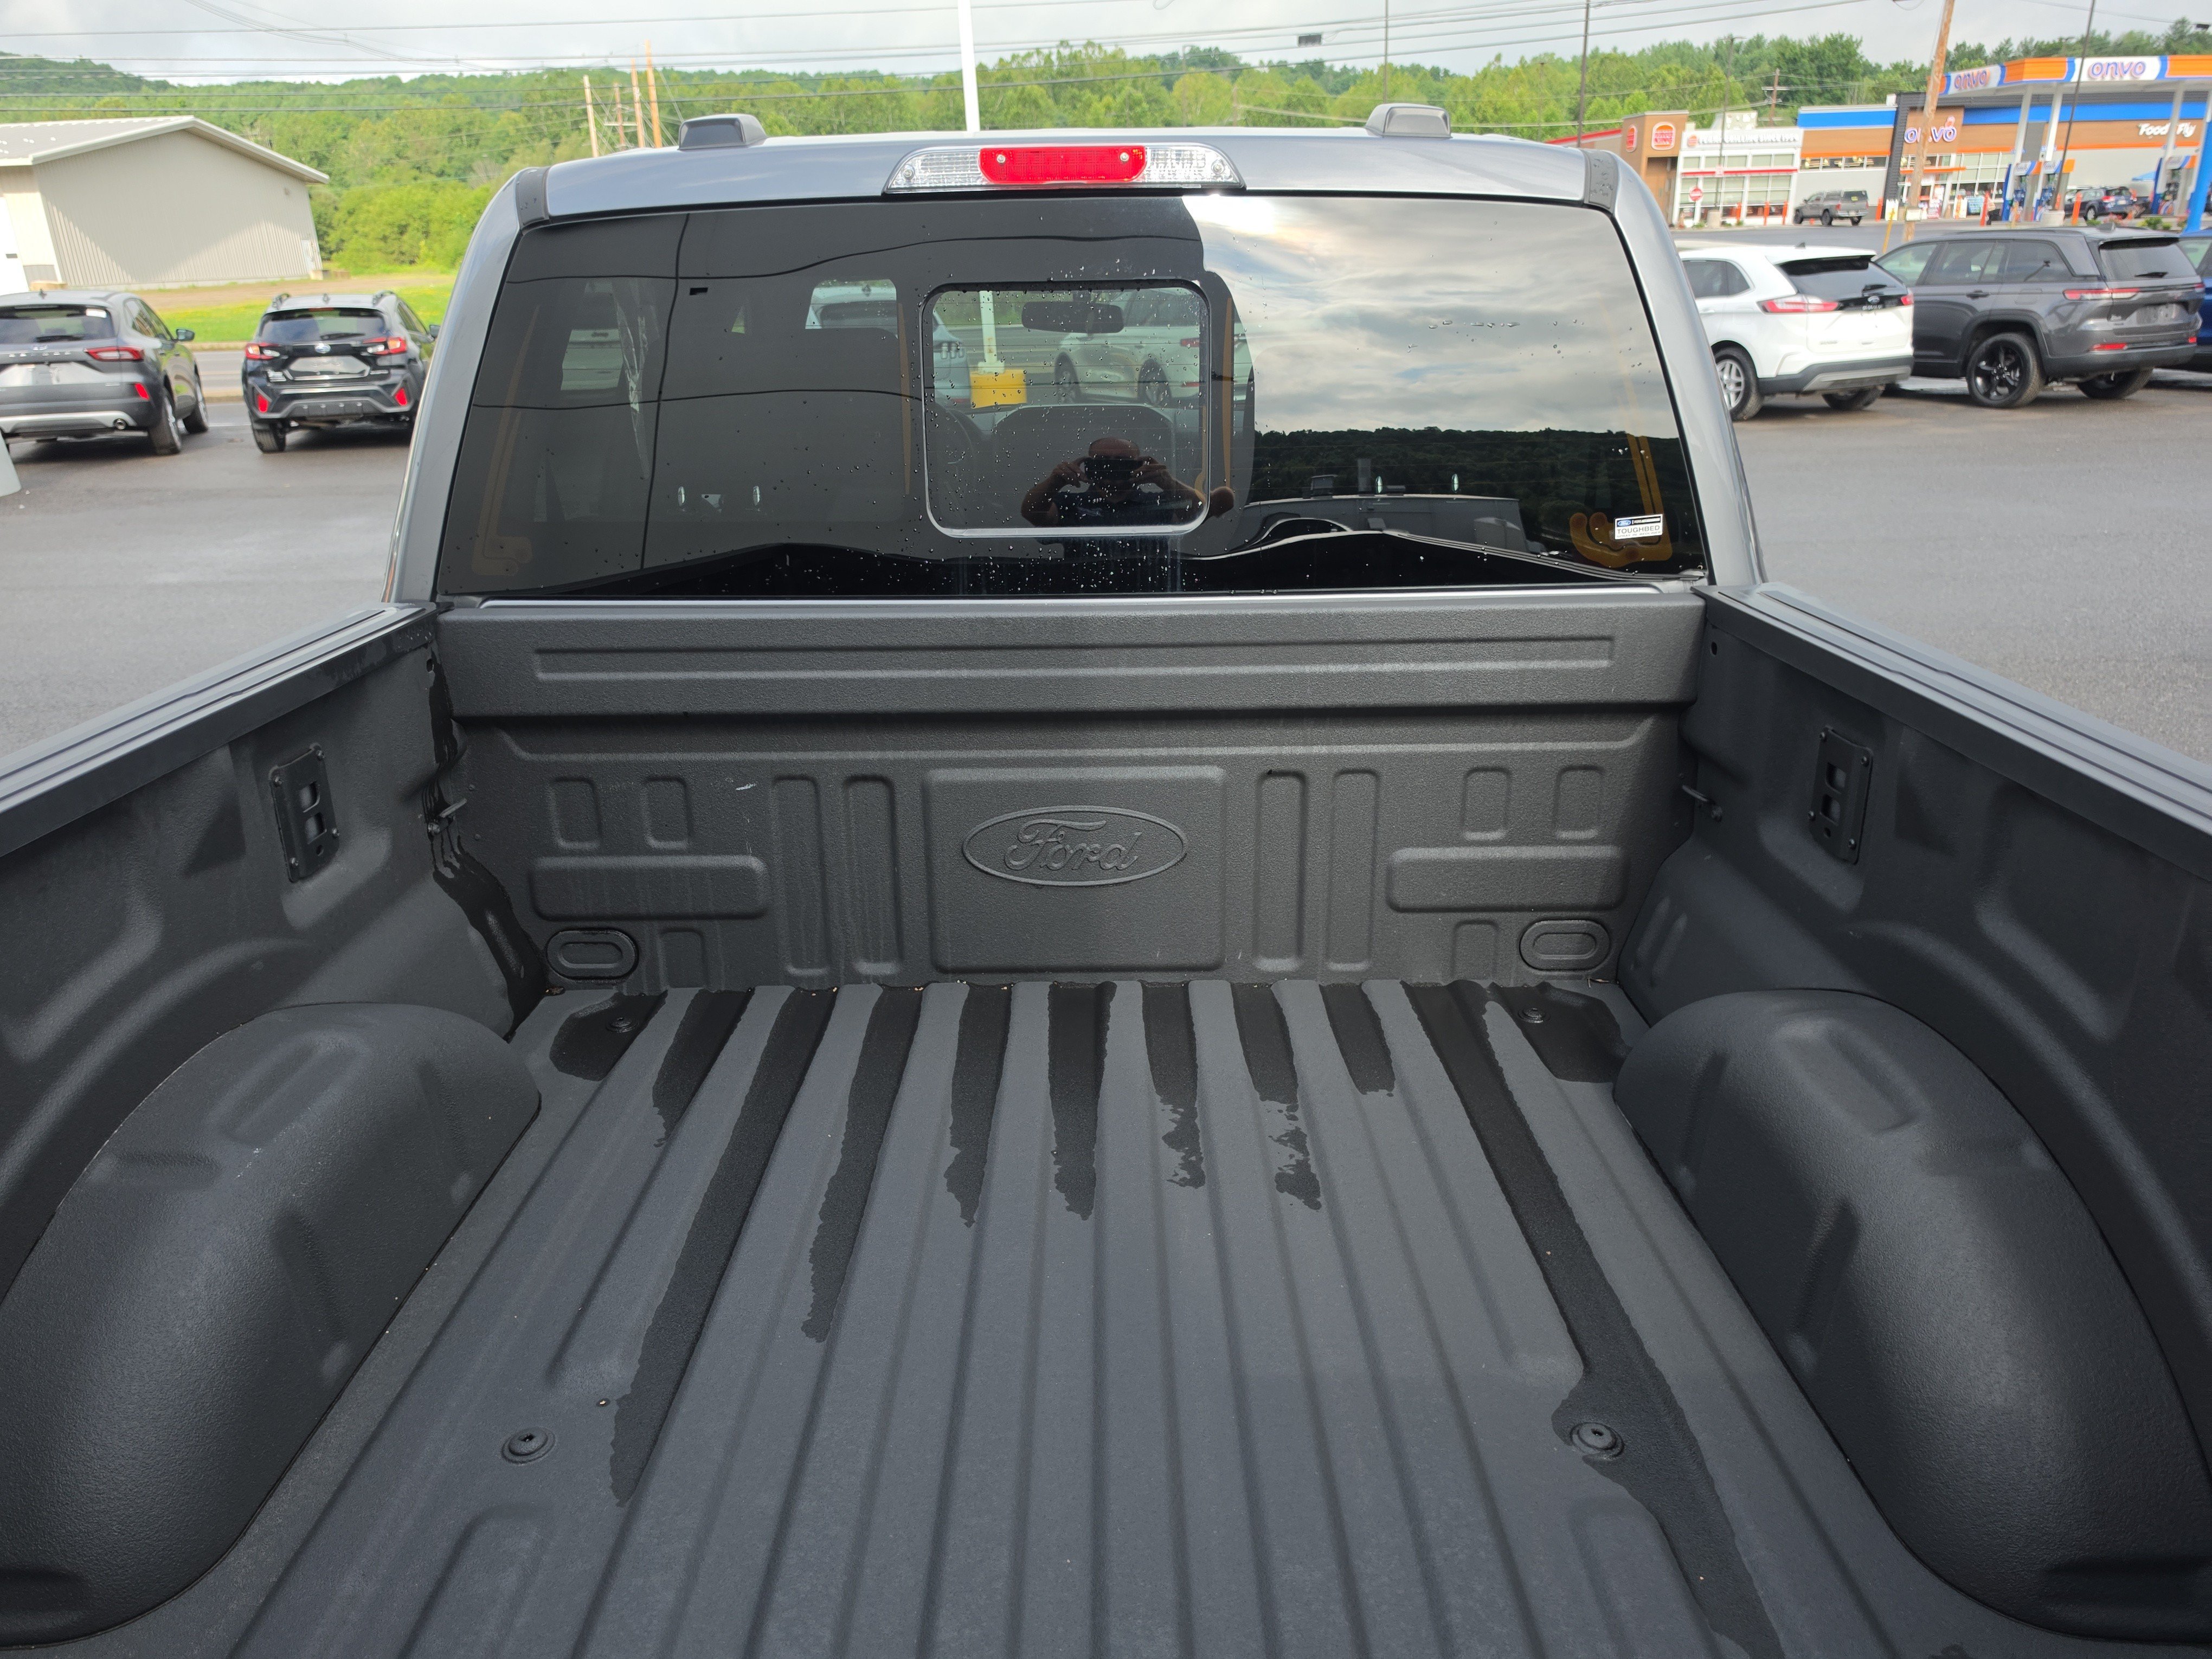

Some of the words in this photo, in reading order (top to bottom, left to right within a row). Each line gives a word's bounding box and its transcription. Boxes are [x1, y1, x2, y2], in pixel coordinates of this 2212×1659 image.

[2089, 61, 2147, 78] onvo
[1953, 69, 1991, 90] onvo
[1904, 126, 1957, 144] ovo
[2138, 123, 2171, 136] Food
[1617, 525, 1660, 534] TOUGHBED
[1004, 819, 1142, 871] Ford
